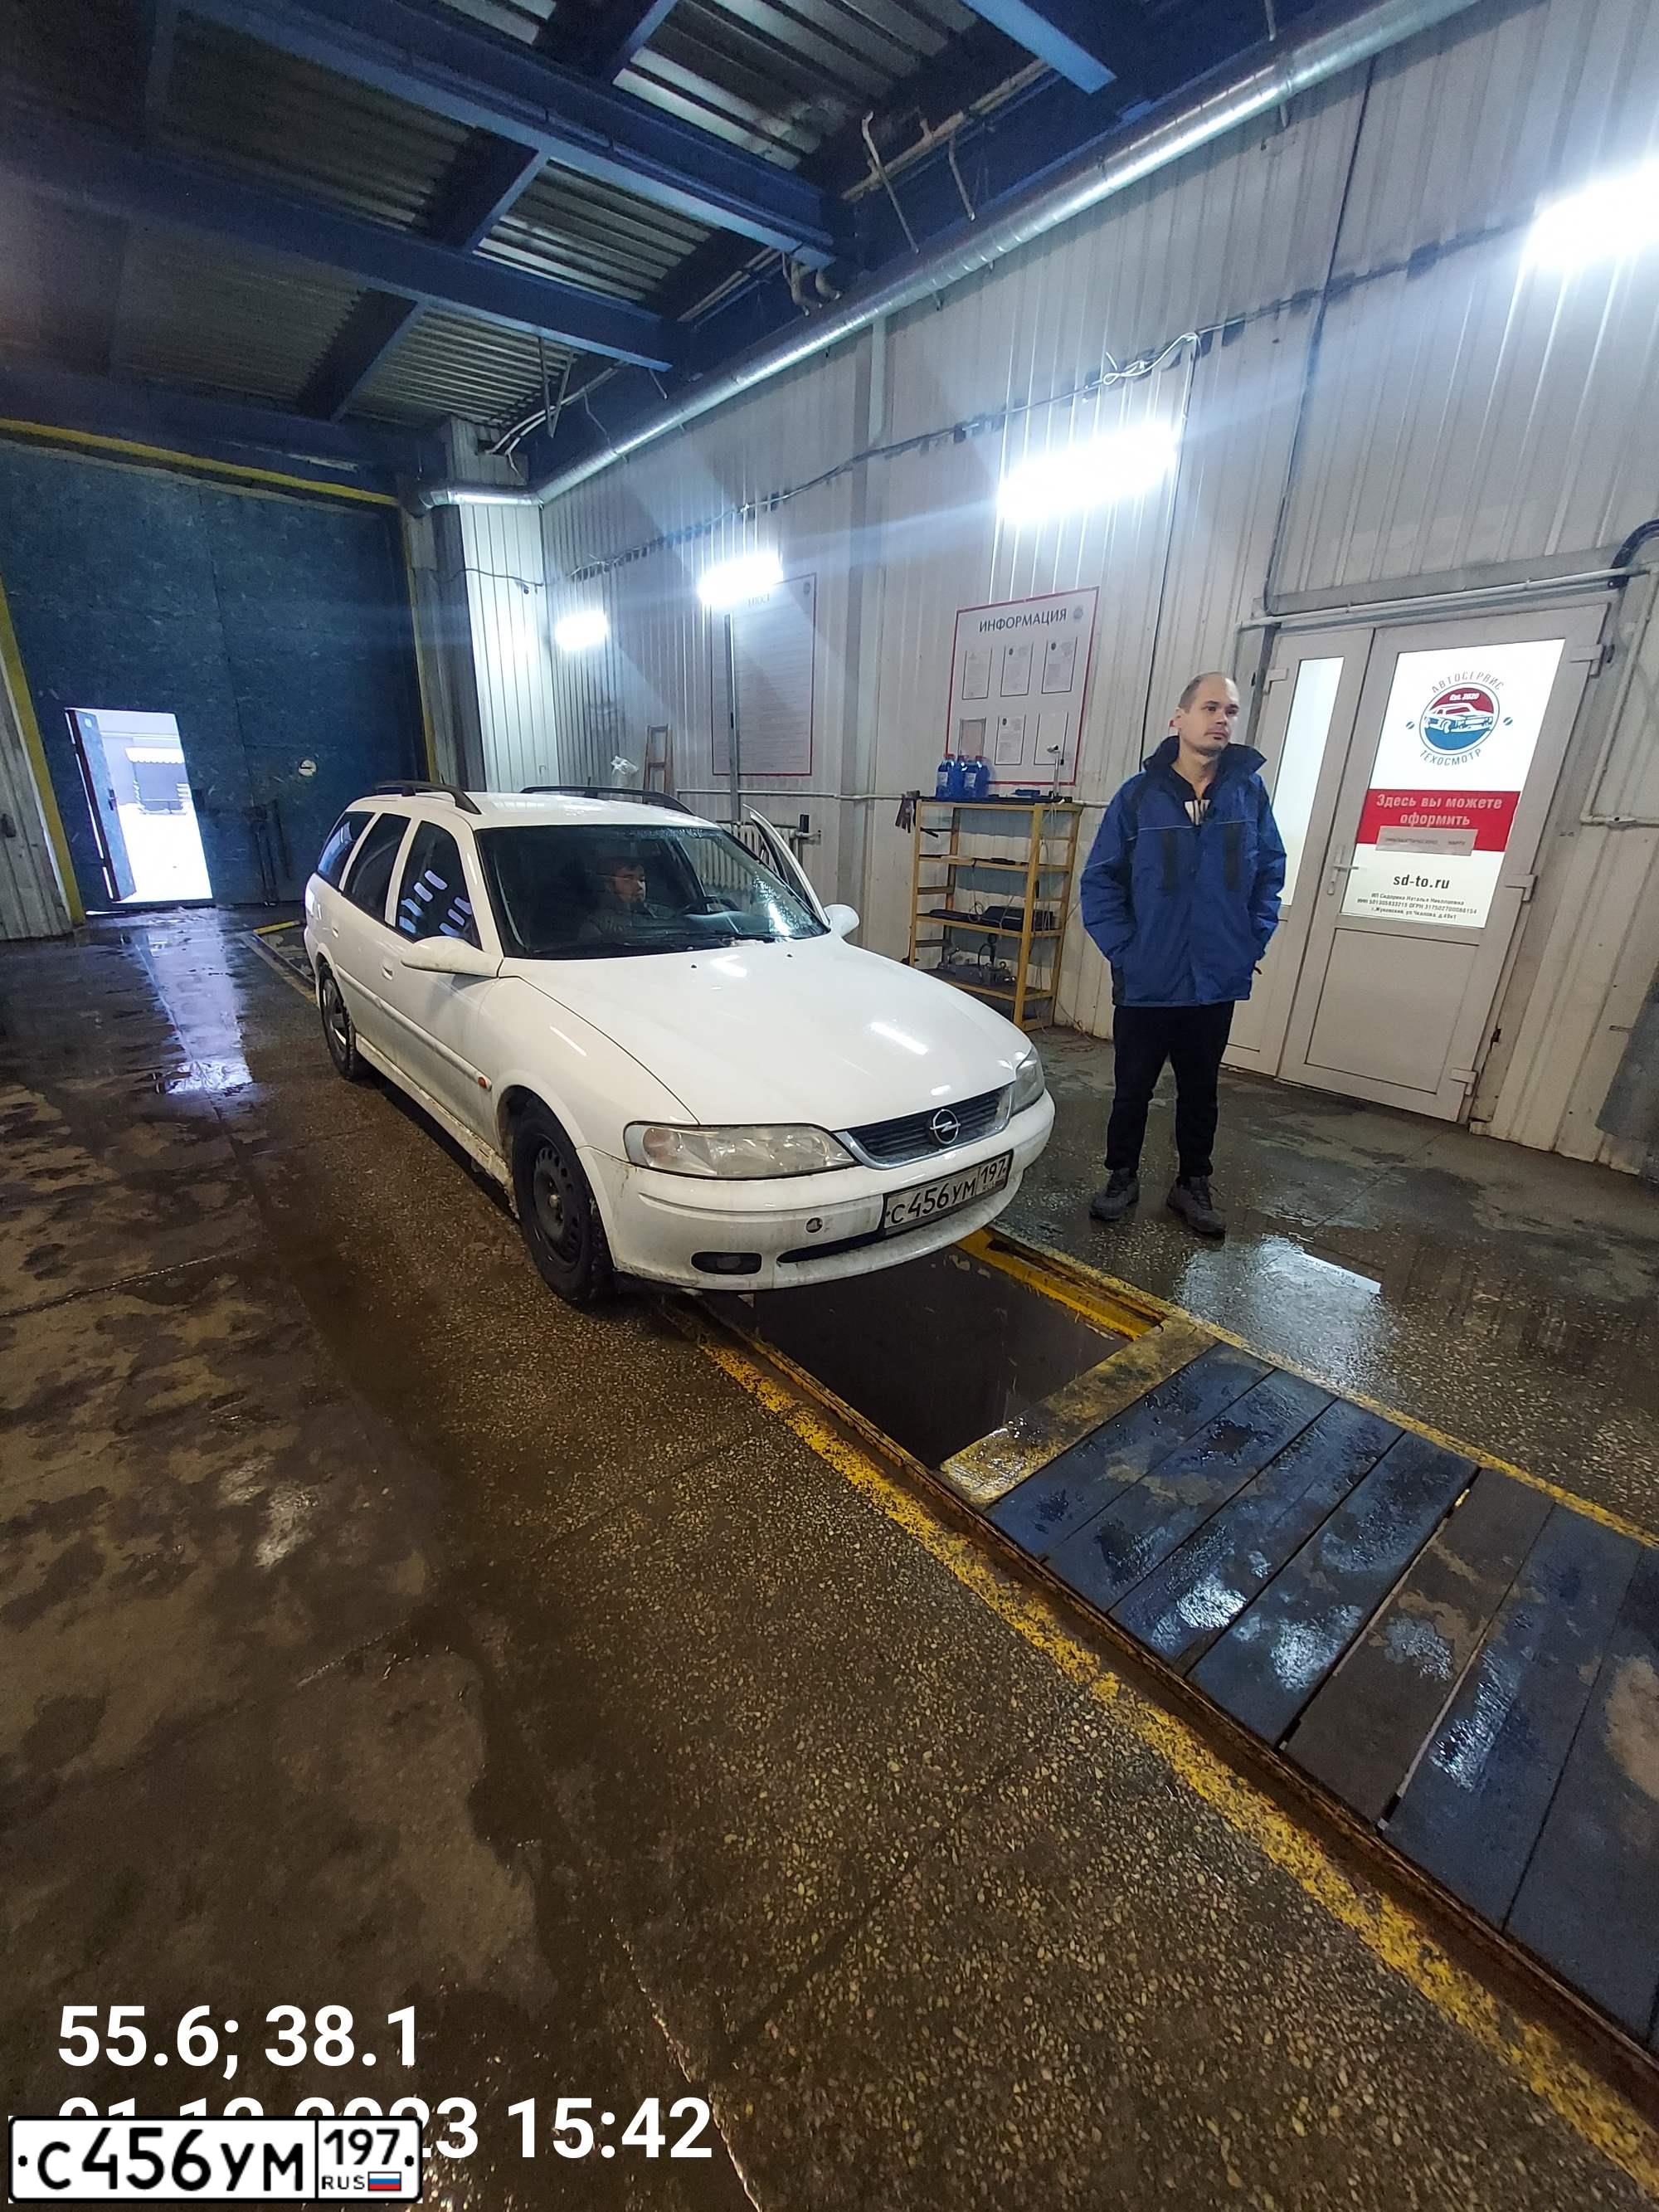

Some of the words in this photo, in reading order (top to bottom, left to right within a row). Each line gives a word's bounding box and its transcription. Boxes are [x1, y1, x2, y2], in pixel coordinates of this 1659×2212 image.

[979, 607, 1068, 632] ИНФОРМАЦИЯ
[1432, 670, 1504, 693] АВТОСЕРВИС
[1419, 748, 1481, 766] ТЕХОСМОТР
[1376, 793, 1417, 807] Здесь
[1420, 797, 1441, 807] вы
[1445, 797, 1502, 809] можете
[1399, 811, 1471, 827] оформить
[1393, 874, 1450, 889] sd-to.ru
[891, 1178, 977, 1225] С456УМ
[980, 1158, 1006, 1184] 197
